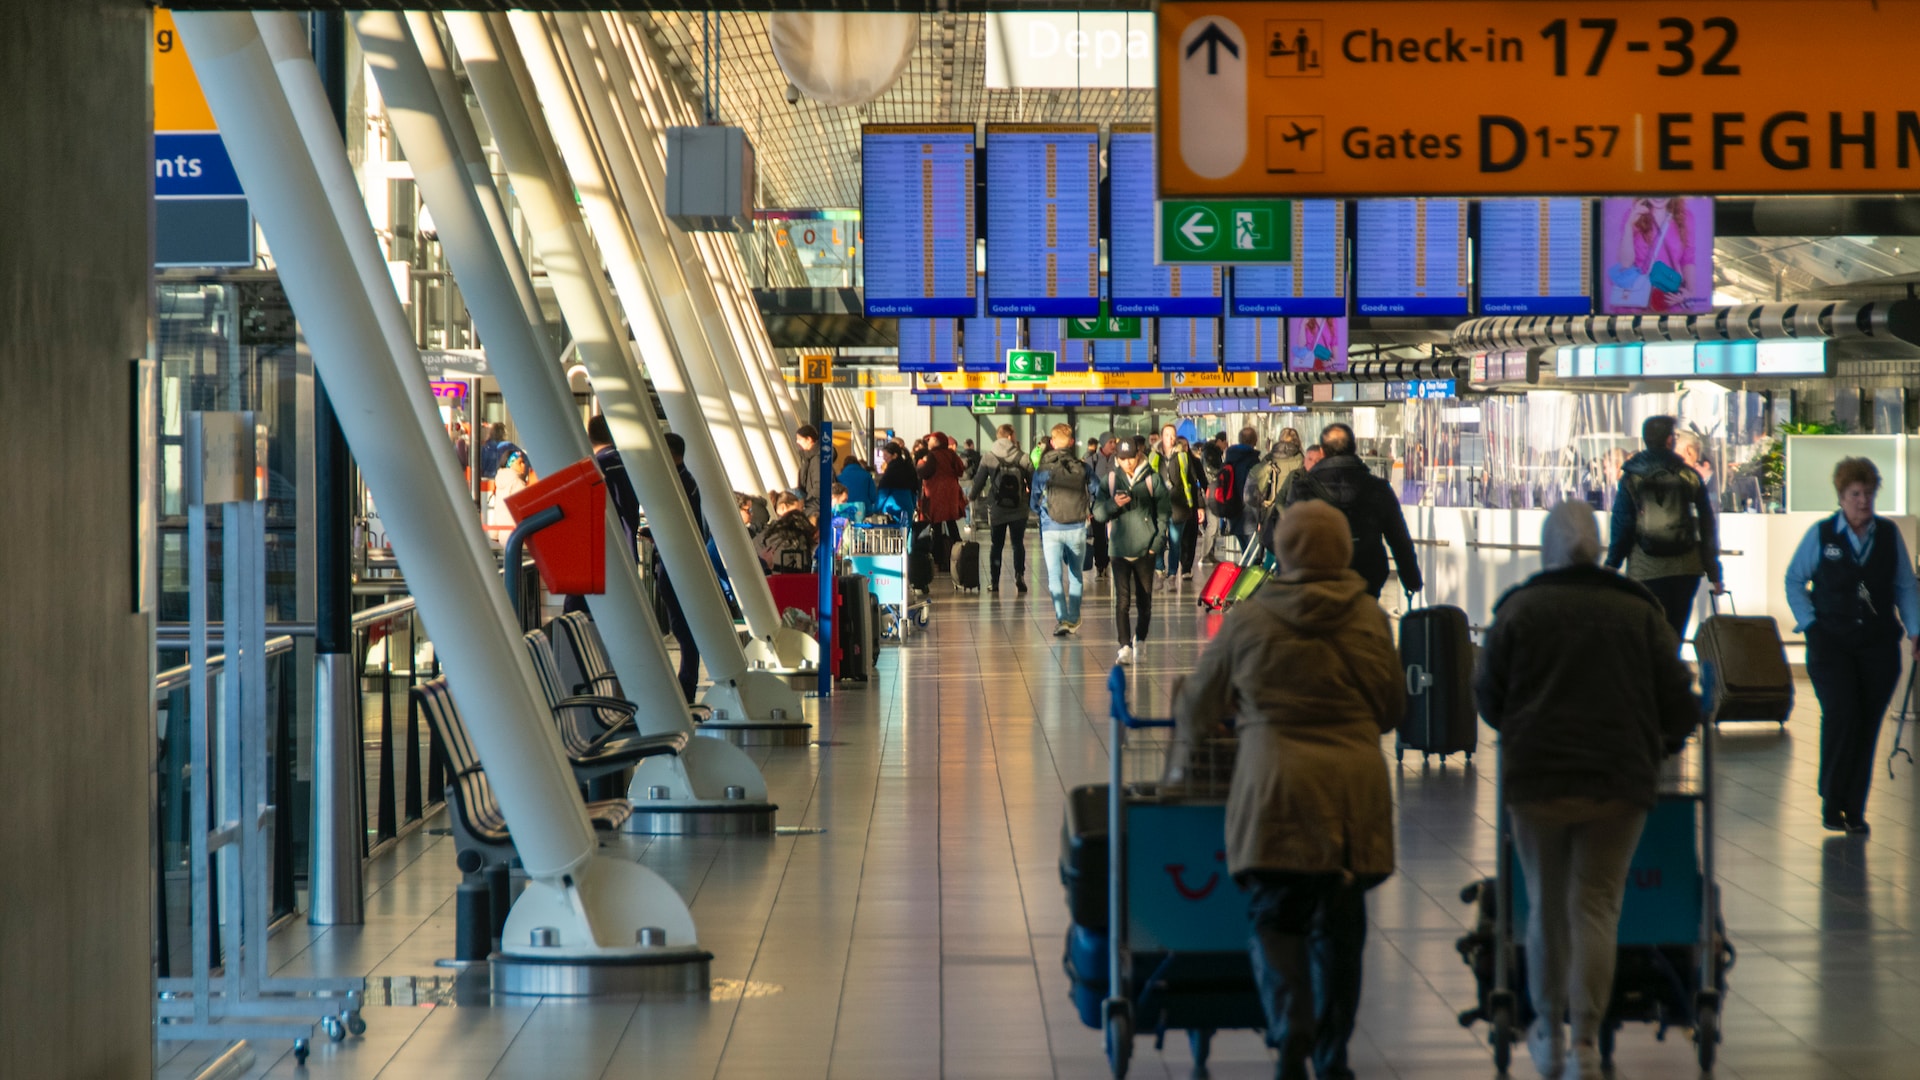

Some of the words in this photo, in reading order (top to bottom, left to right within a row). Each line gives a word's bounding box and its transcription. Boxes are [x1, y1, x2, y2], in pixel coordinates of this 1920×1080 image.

[1028, 20, 1150, 69] Depa
[1342, 27, 1523, 63] Check-in
[1540, 16, 1742, 77] 17-32
[1342, 126, 1462, 160] Gates
[870, 305, 897, 313] Goede
[898, 305, 912, 313] reis
[992, 304, 1019, 312] Goede
[1021, 304, 1035, 312] reis
[1116, 304, 1143, 312] Goede
[1144, 304, 1159, 312] reis
[1239, 304, 1265, 312] Goede
[1267, 304, 1281, 312] reis
[1361, 304, 1387, 312] Goede
[1389, 304, 1404, 312] reis
[1200, 372, 1221, 380] Gates
[1223, 372, 1235, 383] M
